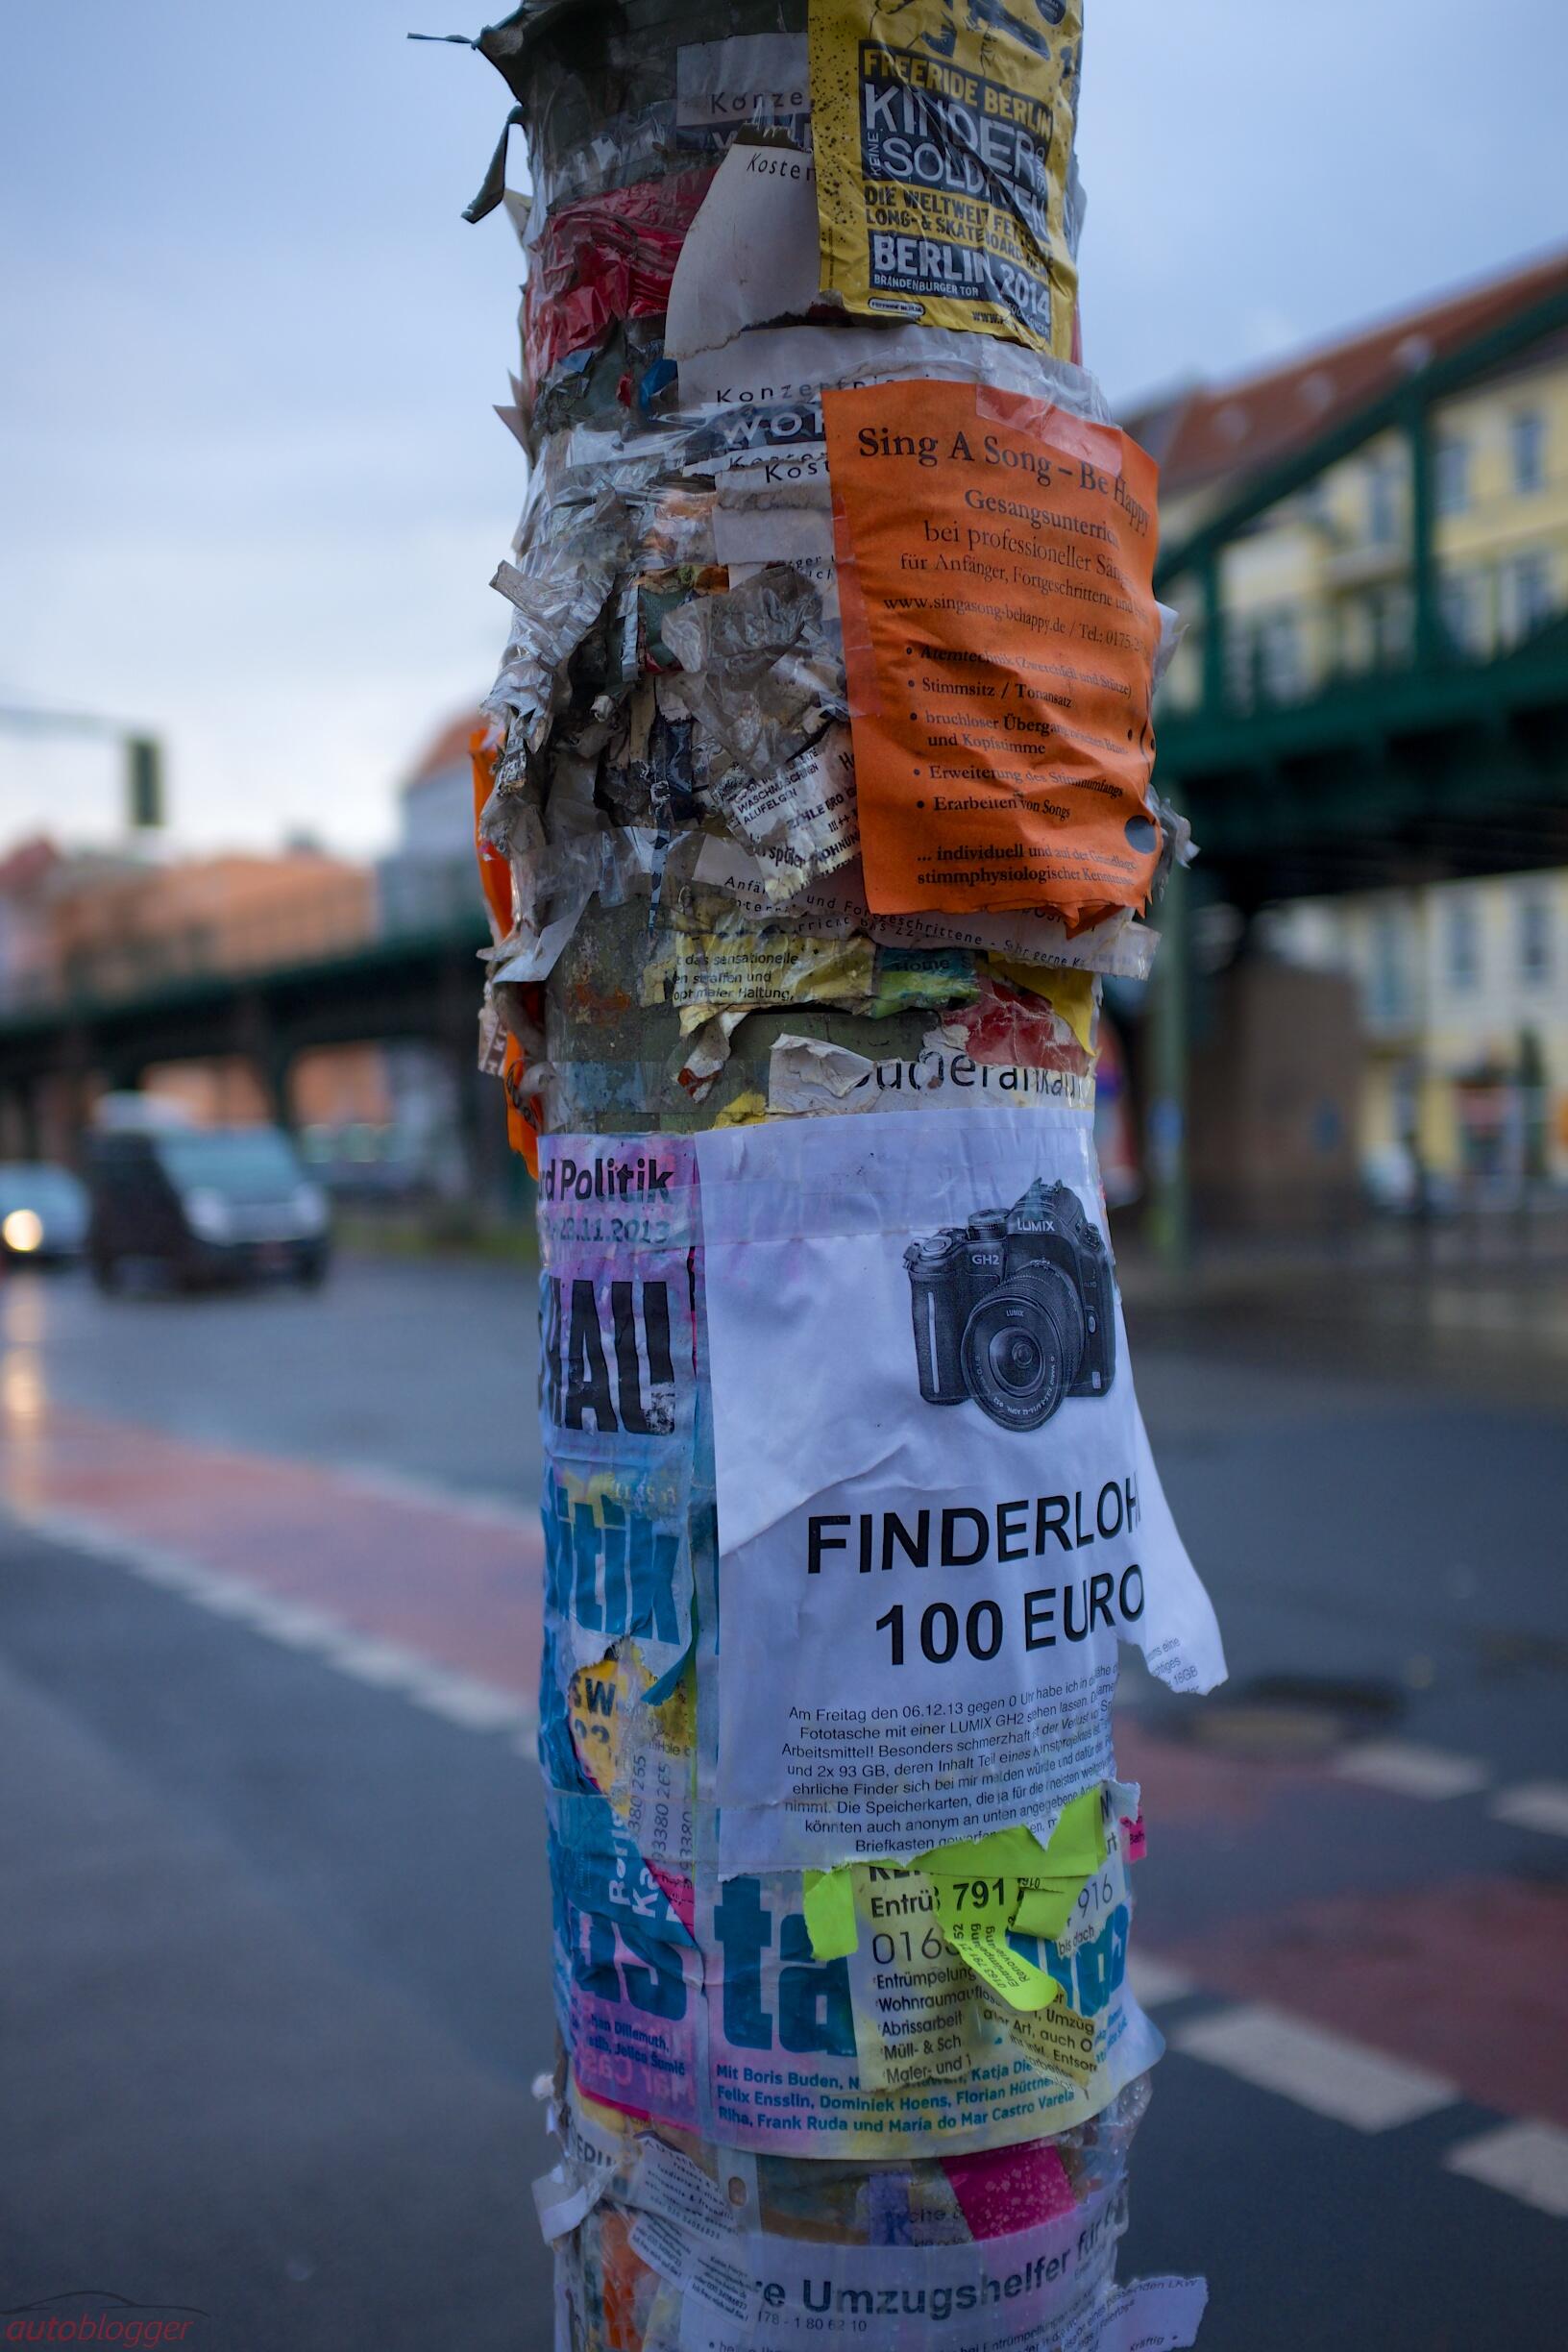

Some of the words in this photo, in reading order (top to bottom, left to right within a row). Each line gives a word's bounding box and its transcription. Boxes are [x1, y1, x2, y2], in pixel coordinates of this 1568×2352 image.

[864, 49, 978, 109] FREERIDE
[984, 86, 1054, 135] BERLIN
[865, 83, 1036, 189] KINDER
[871, 131, 882, 179] KEINE
[864, 185, 894, 207] DIE
[903, 188, 990, 226] WELTWEIT
[873, 234, 992, 283] BERLIN
[1000, 262, 1050, 324] 2014
[873, 274, 957, 296] BRANDENBURGER
[960, 282, 979, 297] TOR
[858, 428, 940, 468] Sing
[947, 430, 976, 462] A
[983, 434, 1052, 487] Song
[1079, 459, 1109, 496] Be
[923, 520, 959, 542] bei
[968, 528, 1091, 576] professioneller
[900, 549, 927, 570] für
[934, 553, 1009, 583] Anfänger,
[1014, 567, 1112, 607] Fortgeschrittene
[883, 594, 1066, 634] www.singasong-behappy.de
[921, 675, 995, 698] Stimmsitz
[1015, 683, 1073, 709] Tonansatz
[925, 709, 999, 729] bruchloser
[927, 734, 958, 747] und
[961, 733, 1047, 754] Kopfstimme
[929, 765, 1023, 785] Erweiterung
[1048, 772, 1123, 799] Stimmumfangs
[933, 796, 1018, 811] Erarbeiten
[1020, 797, 1041, 813] von
[1042, 798, 1071, 822] Songs
[936, 844, 1024, 862] individuell
[1028, 845, 1052, 857] und
[917, 866, 1081, 888] stimmphysiologischer
[806, 894, 836, 911] und
[684, 953, 709, 967] das
[713, 952, 799, 968] sensationelle
[746, 969, 772, 984] und
[738, 986, 796, 1003] Haltung,
[561, 1158, 674, 1204] Politik
[1017, 1216, 1056, 1233] LUMIX
[972, 1254, 1000, 1266] GH2
[807, 1470, 1141, 1575] FINDERLOH
[875, 1599, 1004, 1666] 100
[1023, 1563, 1145, 1653] EURO
[789, 1706, 811, 1721] Am
[817, 1707, 868, 1726] Freitag
[871, 1706, 898, 1720] den
[901, 1701, 964, 1721] 06.12.13
[967, 1698, 1006, 1716] gegen
[1009, 1696, 1017, 1707] 0
[1036, 1684, 1063, 1701] habe
[1066, 1680, 1079, 1694] ich
[799, 1726, 881, 1740] Fototasche
[885, 1724, 907, 1738] mit
[910, 1721, 946, 1736] einer
[950, 1716, 992, 1734] LUMIX
[995, 1712, 1025, 1727] GH2
[781, 1743, 874, 1759] Arbeitsmittel!
[878, 1739, 953, 1759] Besonders
[957, 1729, 1031, 1752] schmerzhaft
[1041, 1723, 1060, 1736] der
[787, 1764, 813, 1777] und
[817, 1765, 835, 1777] 2x
[839, 1765, 858, 1777] 93
[894, 1762, 933, 1776] deren
[937, 1757, 974, 1775] Inhalt
[978, 1752, 997, 1769] Teil
[999, 1750, 1031, 1765] eines
[792, 1782, 848, 1797] ehrliche
[853, 1781, 898, 1797] Finder
[902, 1778, 930, 1794] sich
[935, 1776, 954, 1791] bei
[958, 1774, 979, 1789] mir
[981, 1768, 1024, 1786] melden
[1057, 1752, 1073, 1769] und
[837, 1801, 861, 1814] Die
[865, 1796, 972, 1819] Speicherkarten,
[976, 1790, 995, 1804] die
[997, 1789, 1010, 1806] ja
[1012, 1783, 1027, 1800] für
[1029, 1779, 1044, 1797] die
[804, 1819, 863, 1834] könnten
[867, 1819, 900, 1833] auch
[904, 1816, 959, 1834] anonym
[963, 1814, 981, 1826] an
[983, 1807, 1017, 1824] unten
[855, 1836, 935, 1853] Briefkasten
[952, 1877, 1005, 1912] 791
[1077, 1873, 1114, 1919] 916
[1058, 1939, 1073, 1956] bis
[877, 1966, 978, 1992] Entrümpelung
[884, 2043, 919, 2061] Müll-
[923, 2041, 934, 2054] &
[935, 2034, 962, 2051] Sch
[1014, 2019, 1036, 2040] Art,
[1040, 2029, 1075, 2050] auch
[716, 2064, 739, 2081] Mit
[743, 2068, 783, 2086] Boris
[788, 2071, 845, 2091] Buden,
[971, 2065, 1010, 2084] Katja
[886, 2064, 933, 2085] Maler-
[936, 2057, 963, 2077] und
[717, 2085, 750, 2105] Felix
[754, 2092, 816, 2111] Ensslin,
[820, 2095, 895, 2113] Dominiek
[899, 2095, 952, 2113] Hoens,
[956, 2087, 1006, 2107] Florian
[718, 2104, 754, 2129] Riha,
[757, 2113, 802, 2131] Frank
[806, 2115, 848, 2132] Ruda
[853, 2119, 884, 2133] und
[888, 2116, 933, 2133] Maria
[937, 2116, 957, 2130] do
[960, 2110, 988, 2127] Mar
[992, 2101, 1035, 2122] Castro
[1038, 2089, 1076, 2111] Varela
[801, 2247, 1071, 2321] Umzugshelfer
[805, 2316, 825, 2331] 80
[852, 2317, 869, 2332] 10
